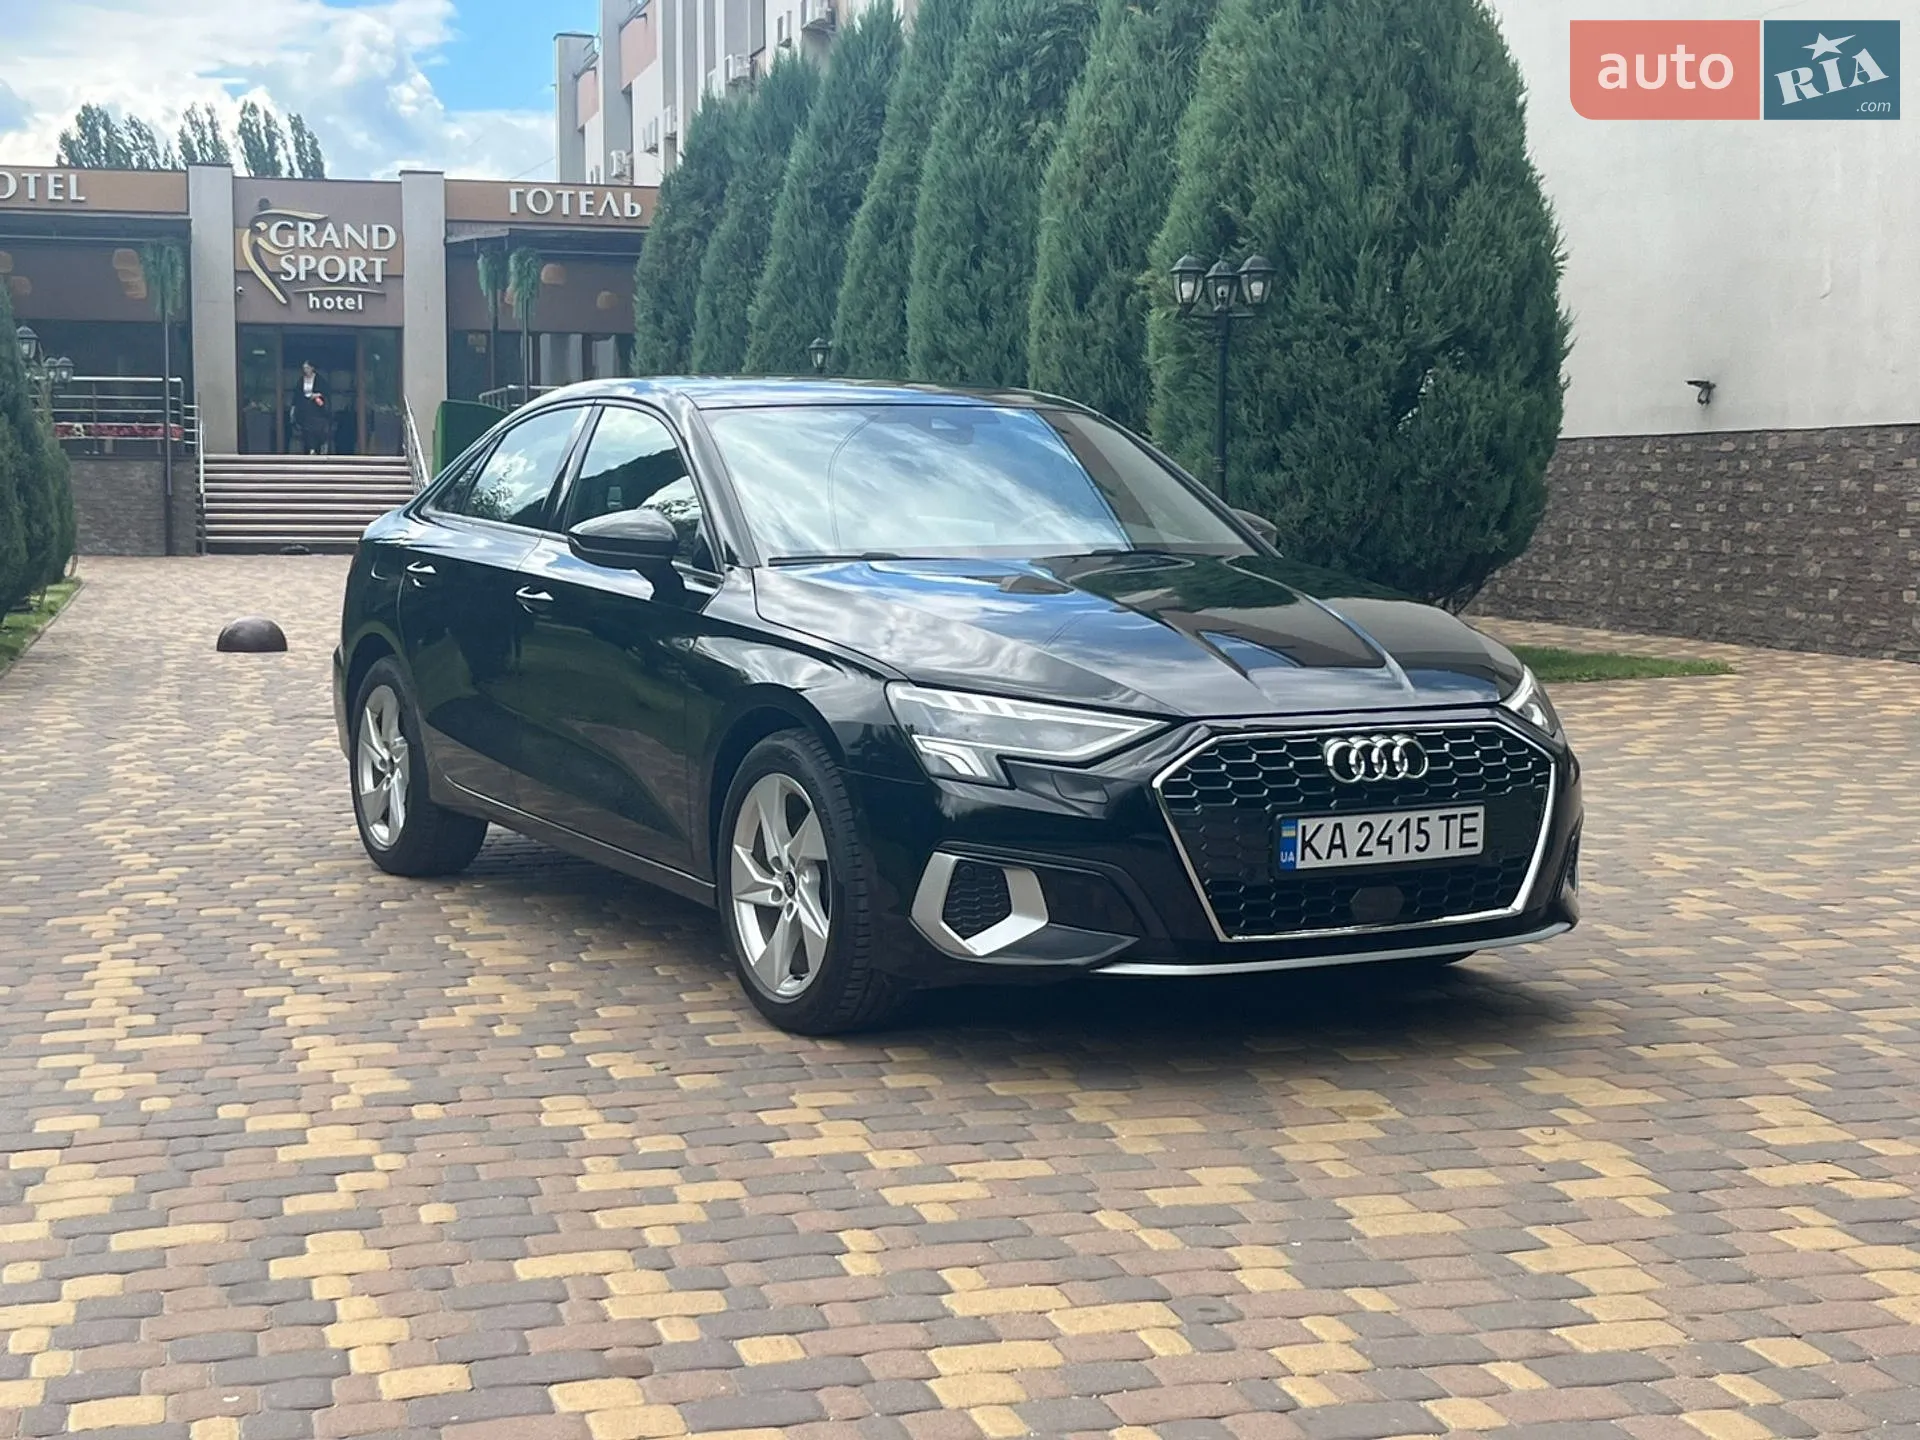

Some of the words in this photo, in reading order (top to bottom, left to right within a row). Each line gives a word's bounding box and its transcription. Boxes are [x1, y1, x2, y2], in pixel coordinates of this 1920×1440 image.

[509, 187, 642, 218] ГОТЕЛЬ
[269, 220, 396, 250] GRAND
[280, 254, 388, 283] SPORT
[308, 293, 363, 310] hotel
[1356, 817, 1430, 857] 2415
[1280, 851, 1295, 863] UA
